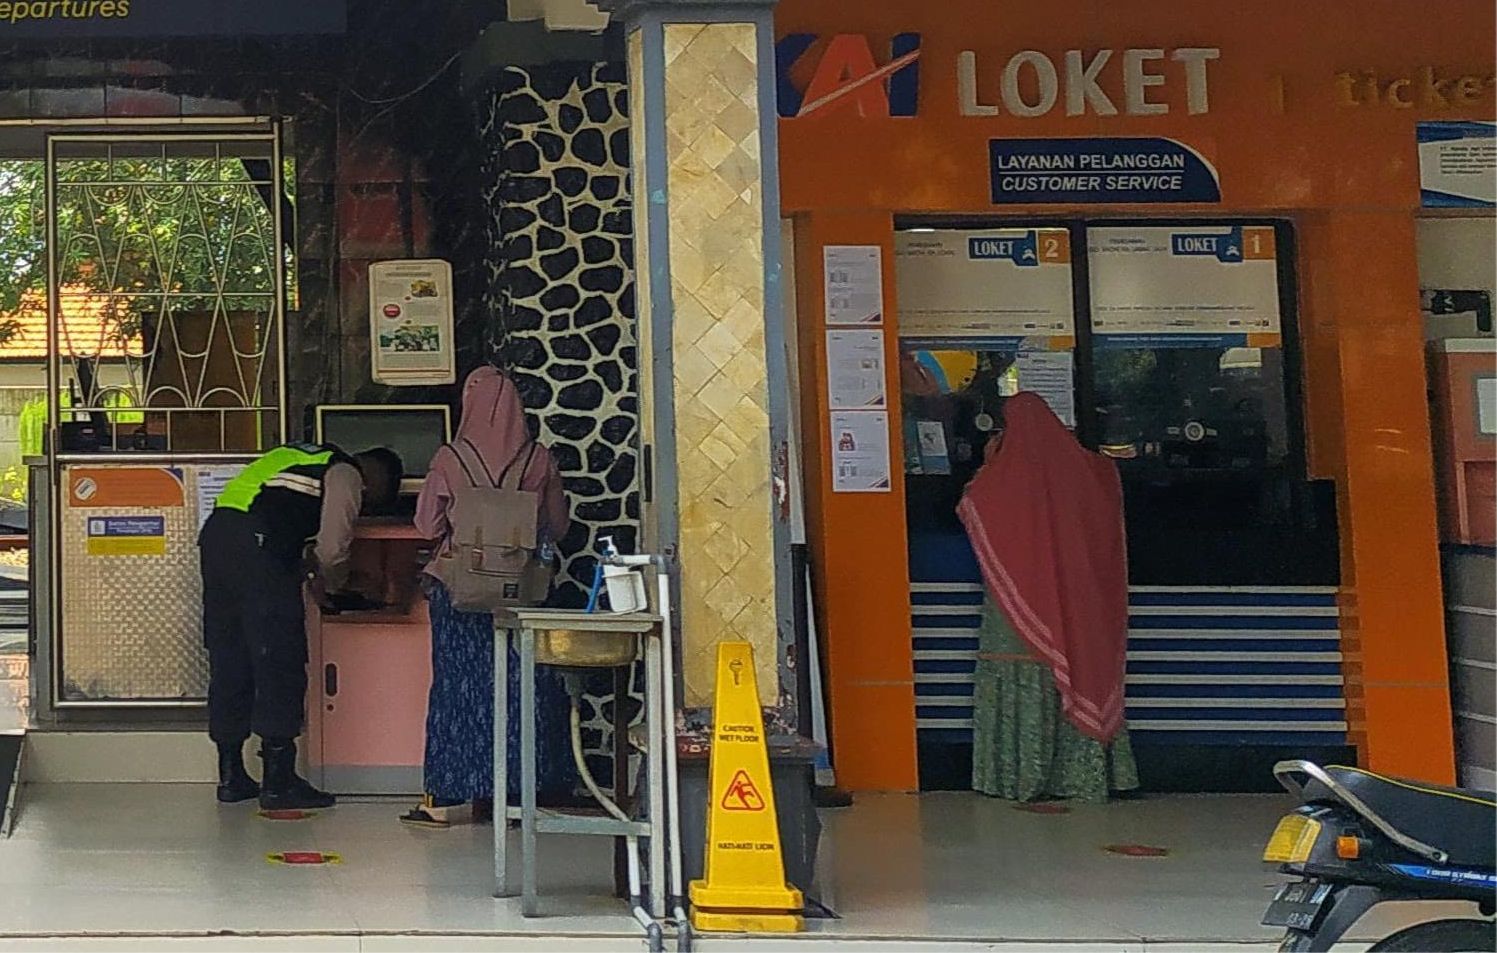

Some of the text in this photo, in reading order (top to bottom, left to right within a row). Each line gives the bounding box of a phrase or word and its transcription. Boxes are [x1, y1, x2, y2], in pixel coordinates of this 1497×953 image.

[956, 47, 1221, 117] LOKET
[997, 152, 1185, 170] LAYANAN PELANGGAN
[1001, 175, 1182, 192] CUSTOMER SERVICE
[974, 240, 1014, 256] LOKET
[1044, 238, 1059, 259] 2
[1177, 237, 1218, 253] LOKET
[1252, 234, 1262, 254] 1
